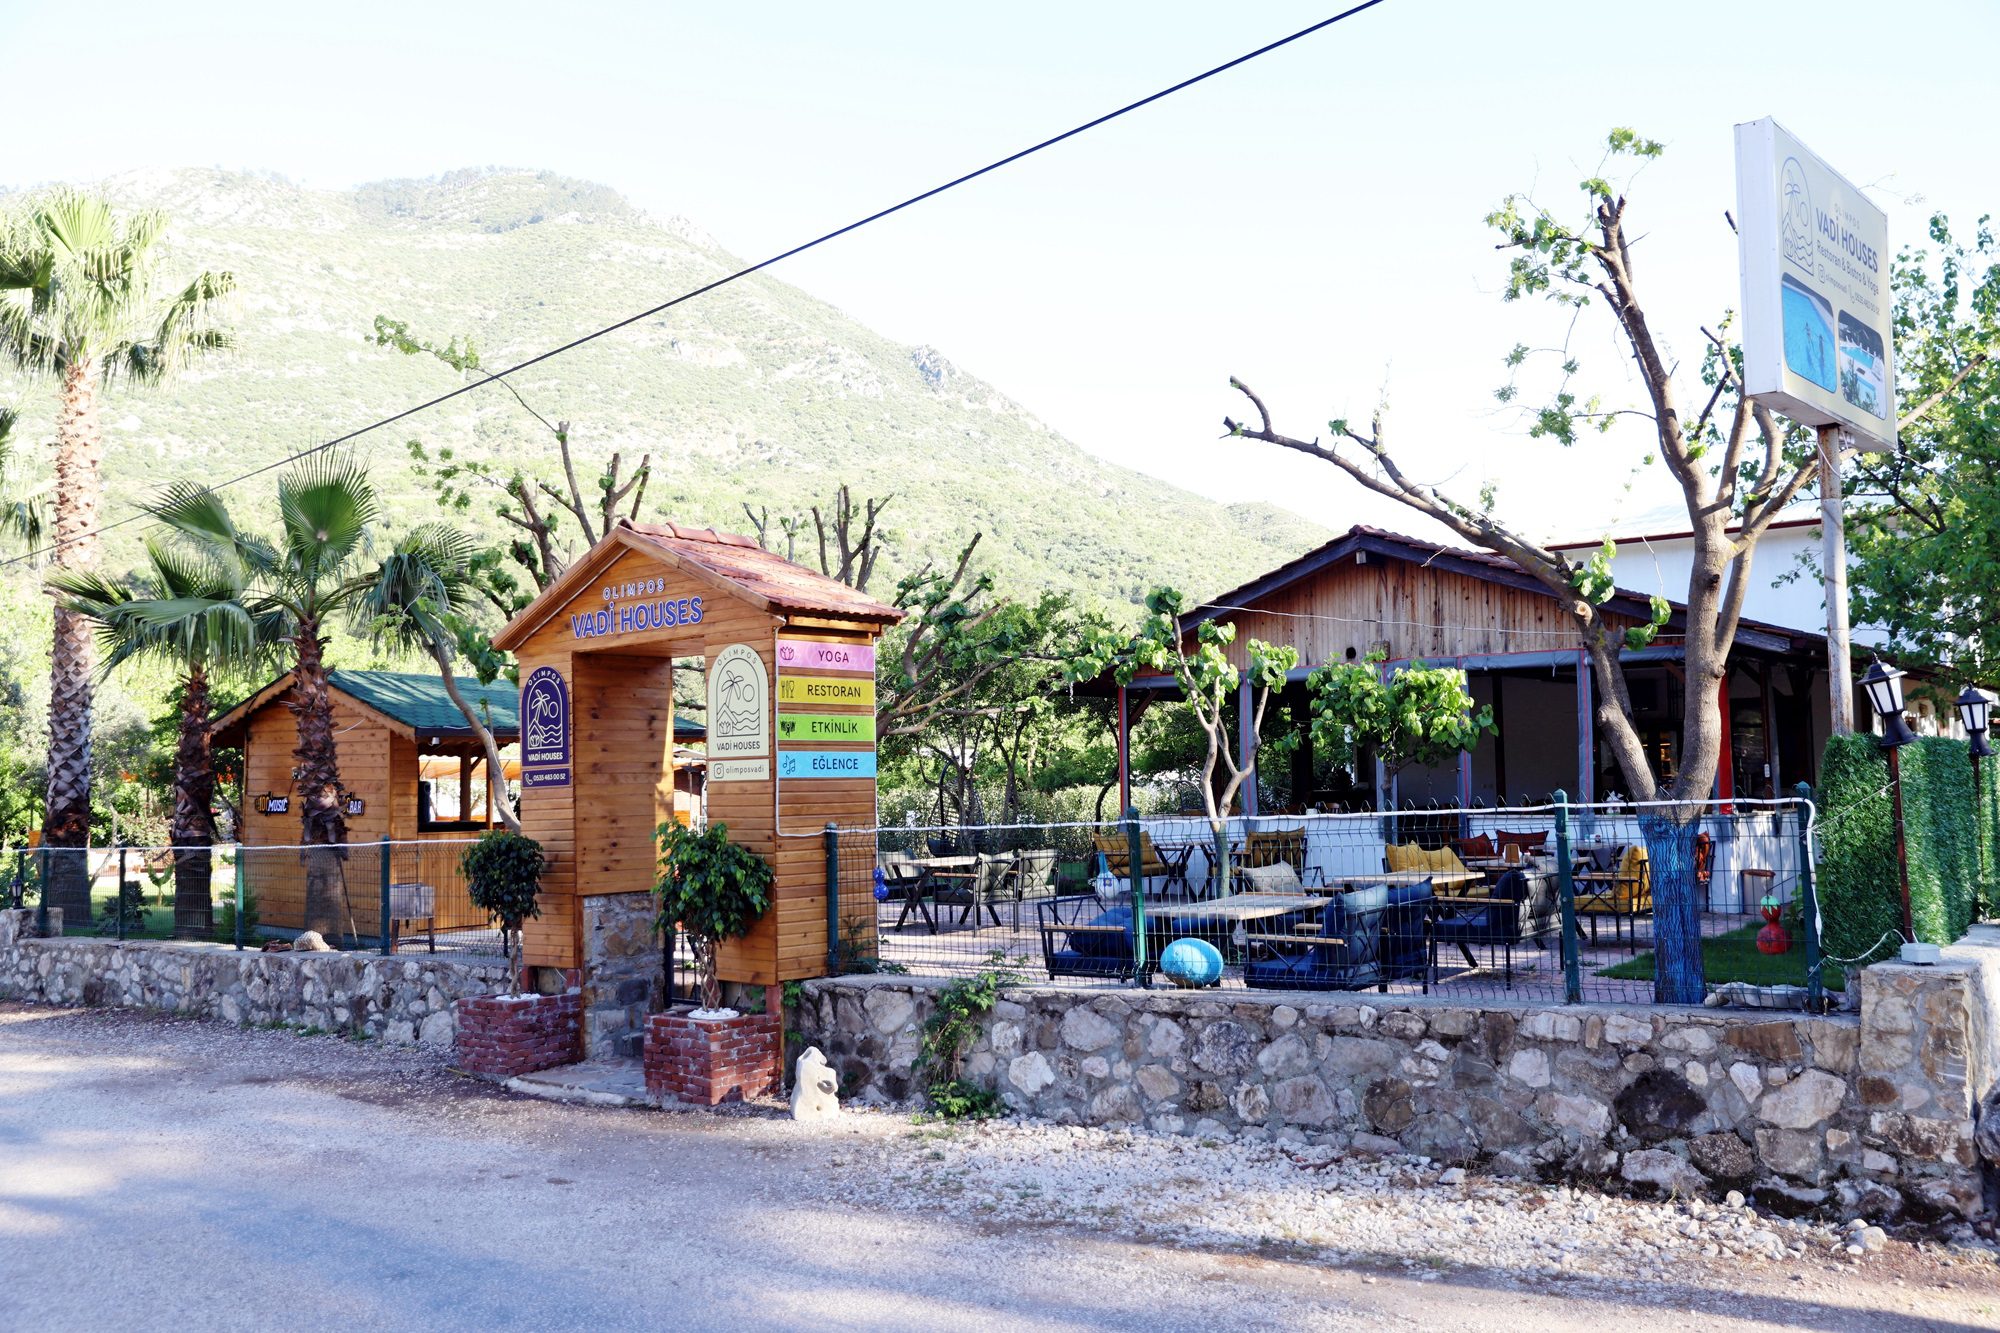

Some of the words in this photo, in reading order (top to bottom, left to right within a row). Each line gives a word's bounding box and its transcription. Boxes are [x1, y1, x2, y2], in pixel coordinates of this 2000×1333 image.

[1816, 208, 1839, 246] VADİ
[1841, 227, 1878, 273] HOUSES
[603, 578, 665, 600] OLIMPOS
[571, 601, 616, 639] VADİ
[619, 595, 703, 633] HOUSES
[717, 648, 758, 666] OLIMPOS
[818, 650, 849, 663] YOGA
[528, 670, 561, 686] OLIMPOS
[807, 684, 861, 698] RESTORAN
[811, 718, 858, 734] ETKİNLİK
[717, 740, 732, 751] VADİ
[733, 741, 760, 750] HOUSES
[528, 751, 541, 761] VADİ
[541, 752, 563, 760] HOUSES
[812, 755, 859, 770] EĞLENCE
[725, 766, 764, 775] olimposvadi
[267, 797, 288, 812] MUSIC
